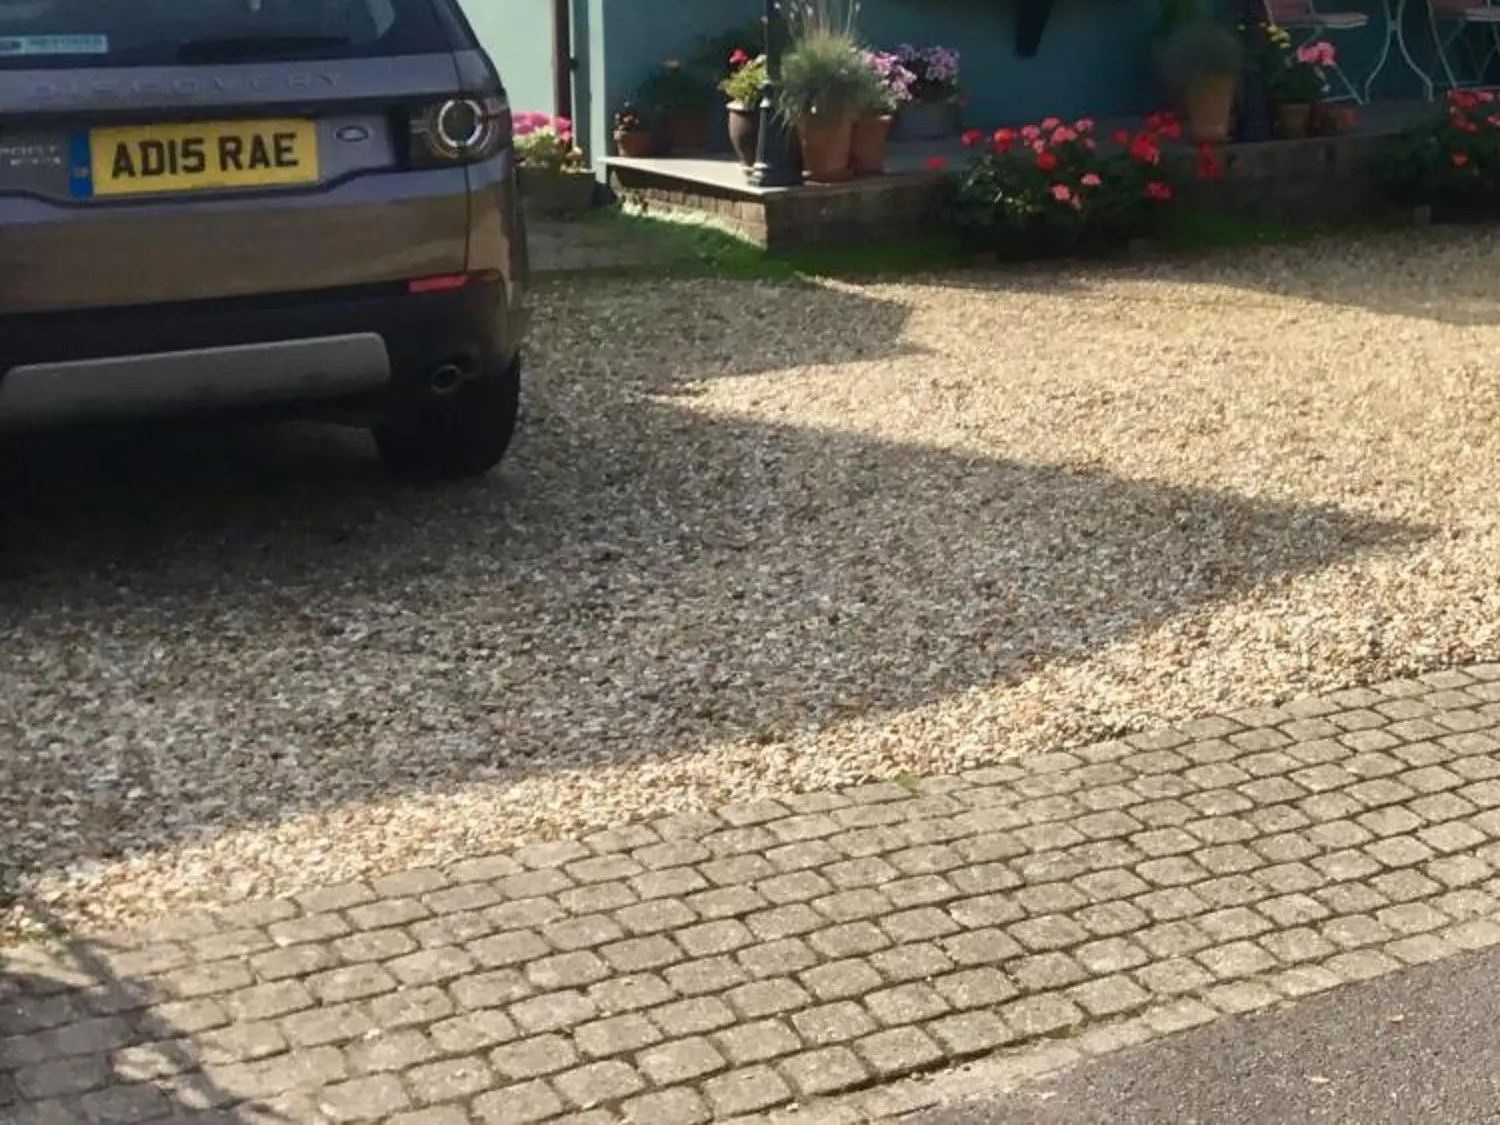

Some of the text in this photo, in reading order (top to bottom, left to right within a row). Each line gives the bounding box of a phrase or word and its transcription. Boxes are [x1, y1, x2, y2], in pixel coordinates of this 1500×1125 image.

[31, 71, 342, 97] DISCOVERY
[111, 132, 299, 179] AD15 RAE
